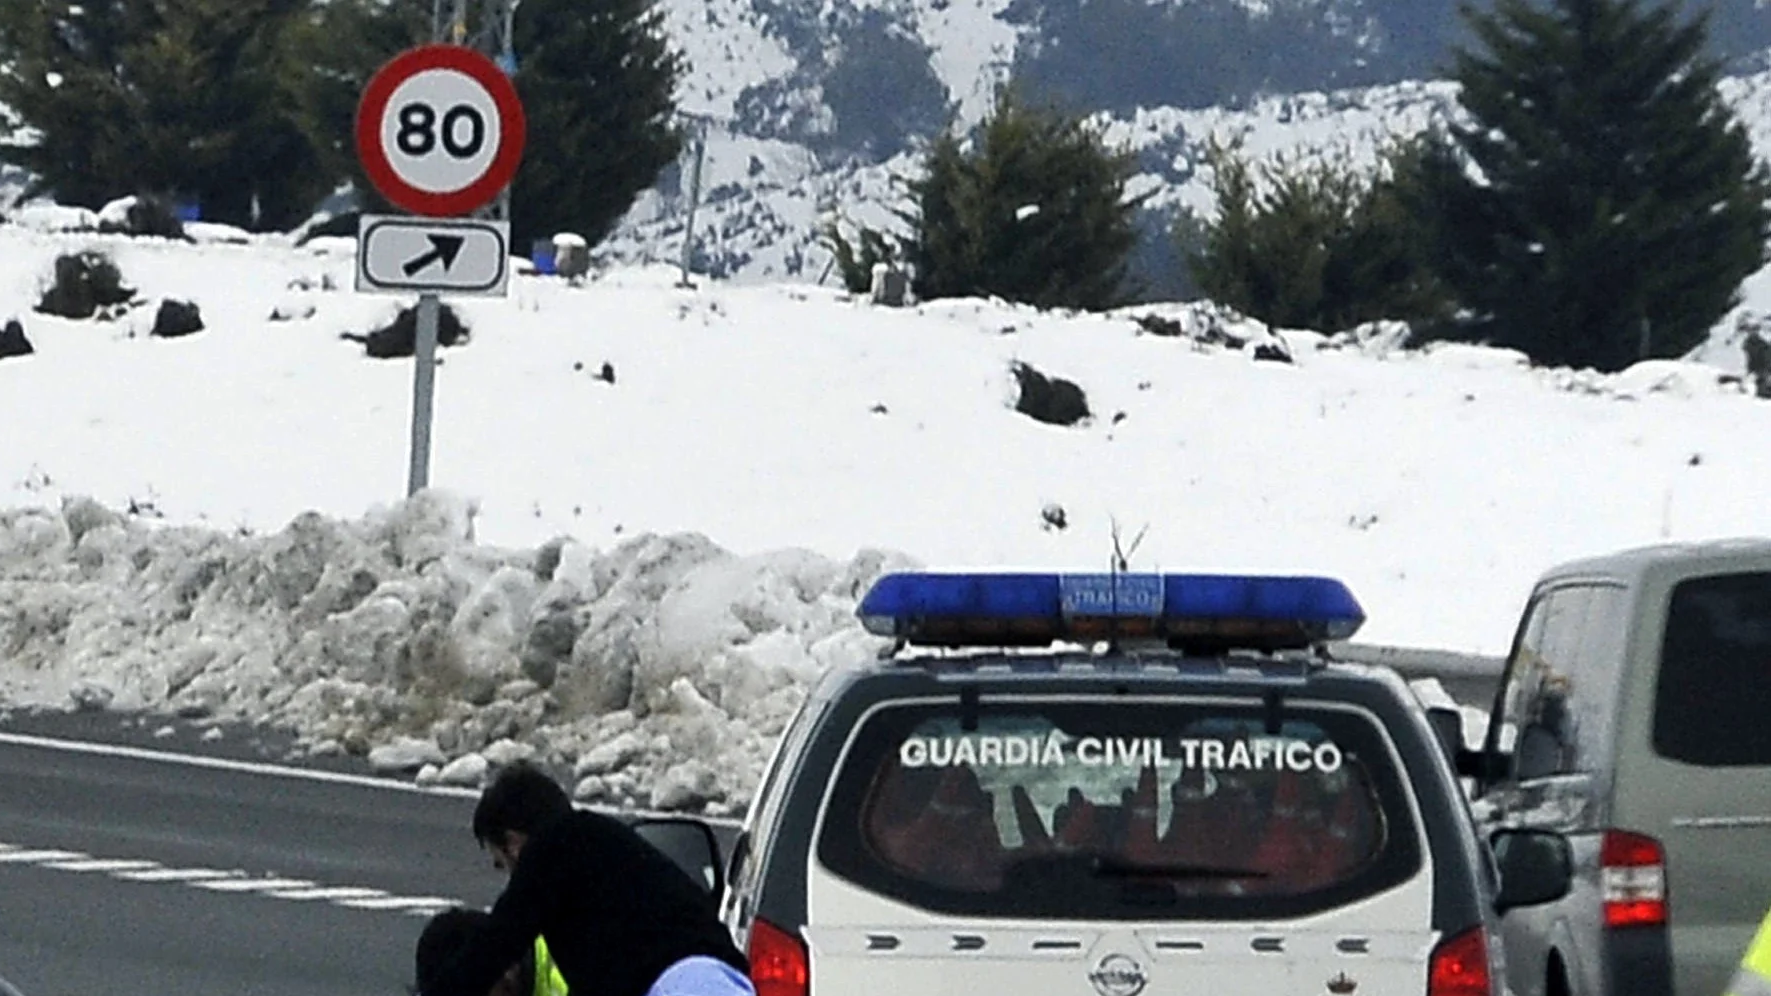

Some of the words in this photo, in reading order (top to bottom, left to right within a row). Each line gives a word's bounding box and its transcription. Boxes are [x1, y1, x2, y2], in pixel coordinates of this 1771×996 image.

[396, 103, 485, 159] 80
[899, 735, 1065, 768] GUARDIA
[1076, 736, 1170, 768] CIVIL
[1181, 738, 1342, 773] TRAFICO
